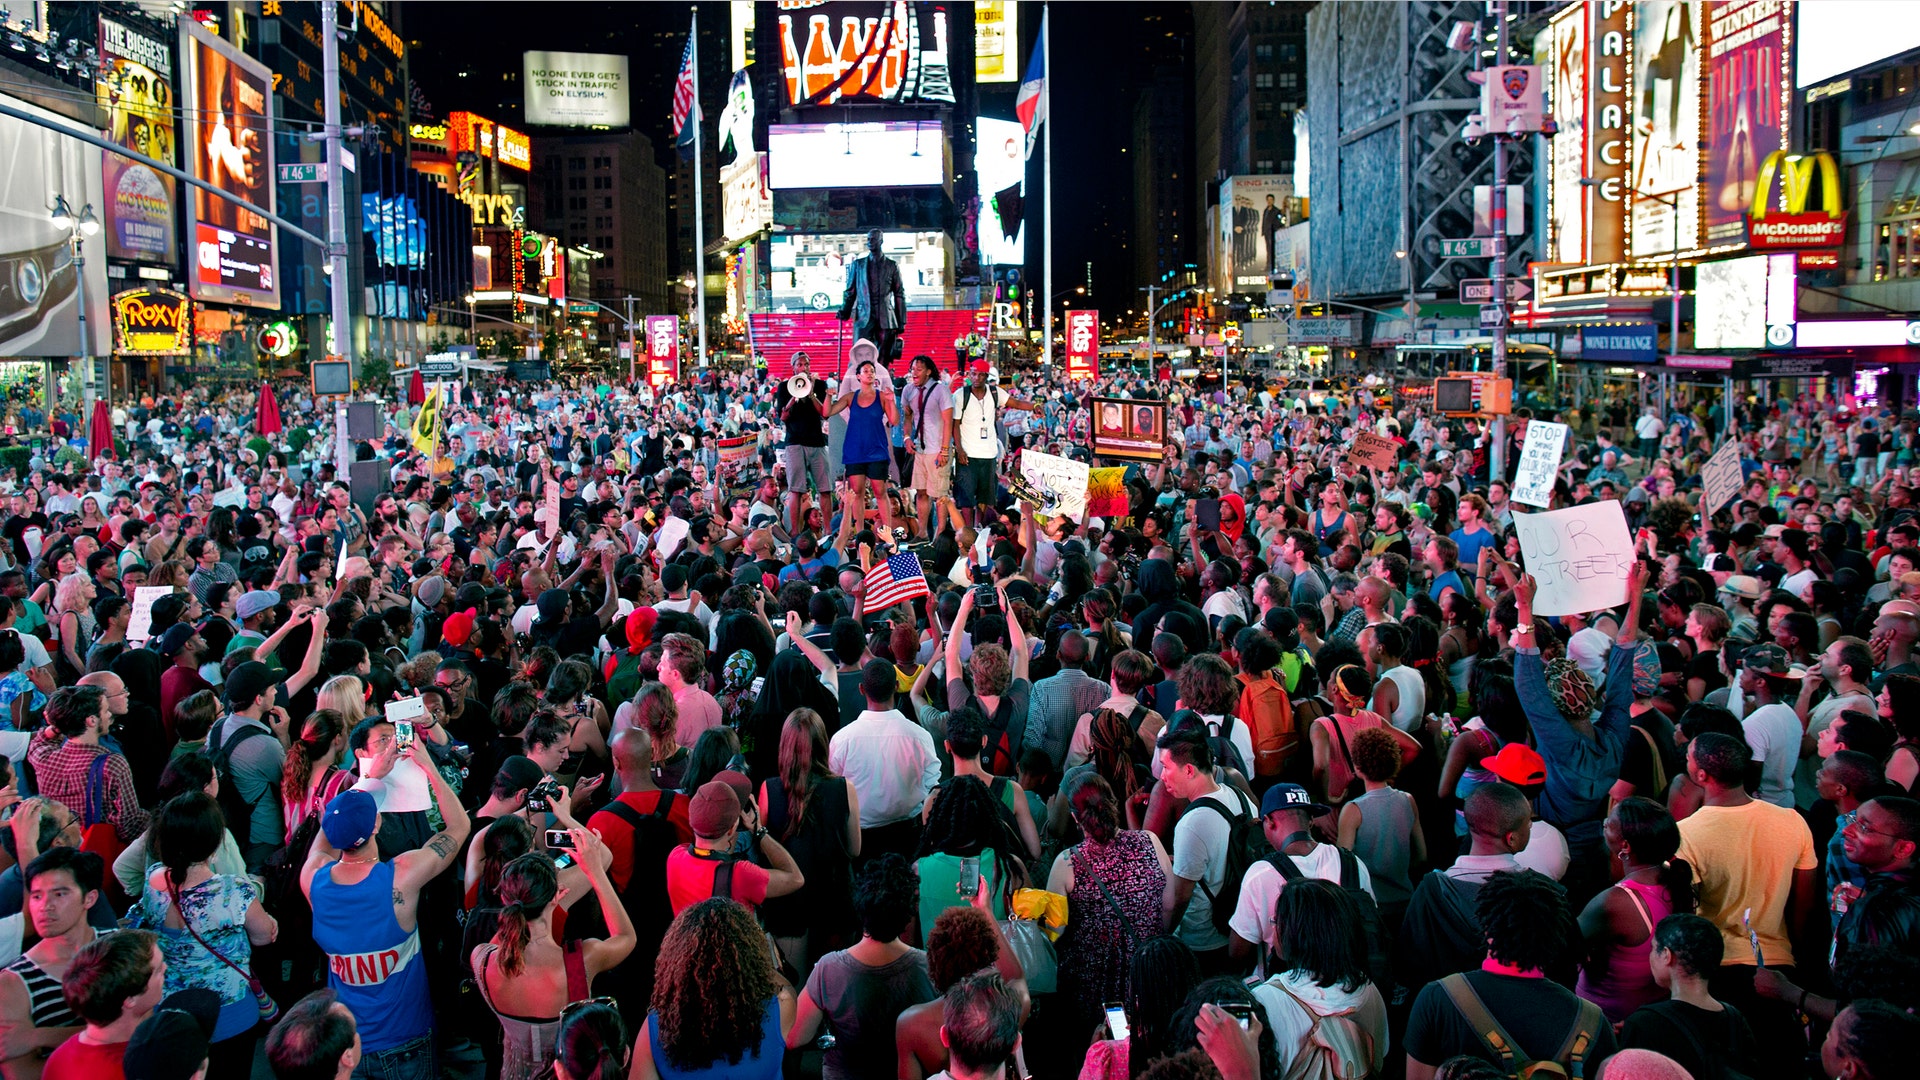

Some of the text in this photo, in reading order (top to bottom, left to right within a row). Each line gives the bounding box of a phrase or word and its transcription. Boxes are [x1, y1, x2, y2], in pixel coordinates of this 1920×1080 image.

[103, 18, 169, 65] THE BIGGEST
[532, 70, 621, 81] NO ONE EVER GETS
[535, 79, 565, 88] STUCK
[580, 82, 618, 90] TRAFFIC
[549, 89, 564, 97] ON
[1708, 46, 1781, 148] PIPPIN
[1601, 0, 1623, 202] PALACE
[281, 165, 314, 180] W 46 ST
[1235, 179, 1262, 187] KING
[115, 191, 168, 216] MOTOWN
[1752, 222, 1843, 235] McDonald's
[1766, 235, 1826, 244] Restaurant
[1443, 240, 1479, 255] W 46 ST
[1468, 286, 1489, 297] ONE
[995, 302, 1022, 329] R
[654, 318, 674, 358] tkts
[1073, 312, 1094, 353] tkts
[1584, 336, 1653, 350] MONEY EXCHANGE
[1530, 425, 1562, 441] STOP
[1357, 432, 1394, 451] JUSTICE
[1351, 446, 1377, 461] LOVE
[1541, 451, 1552, 460] ARE
[1703, 455, 1726, 508] KILLS
[1522, 519, 1604, 559] OUR
[330, 949, 399, 985] RIND
